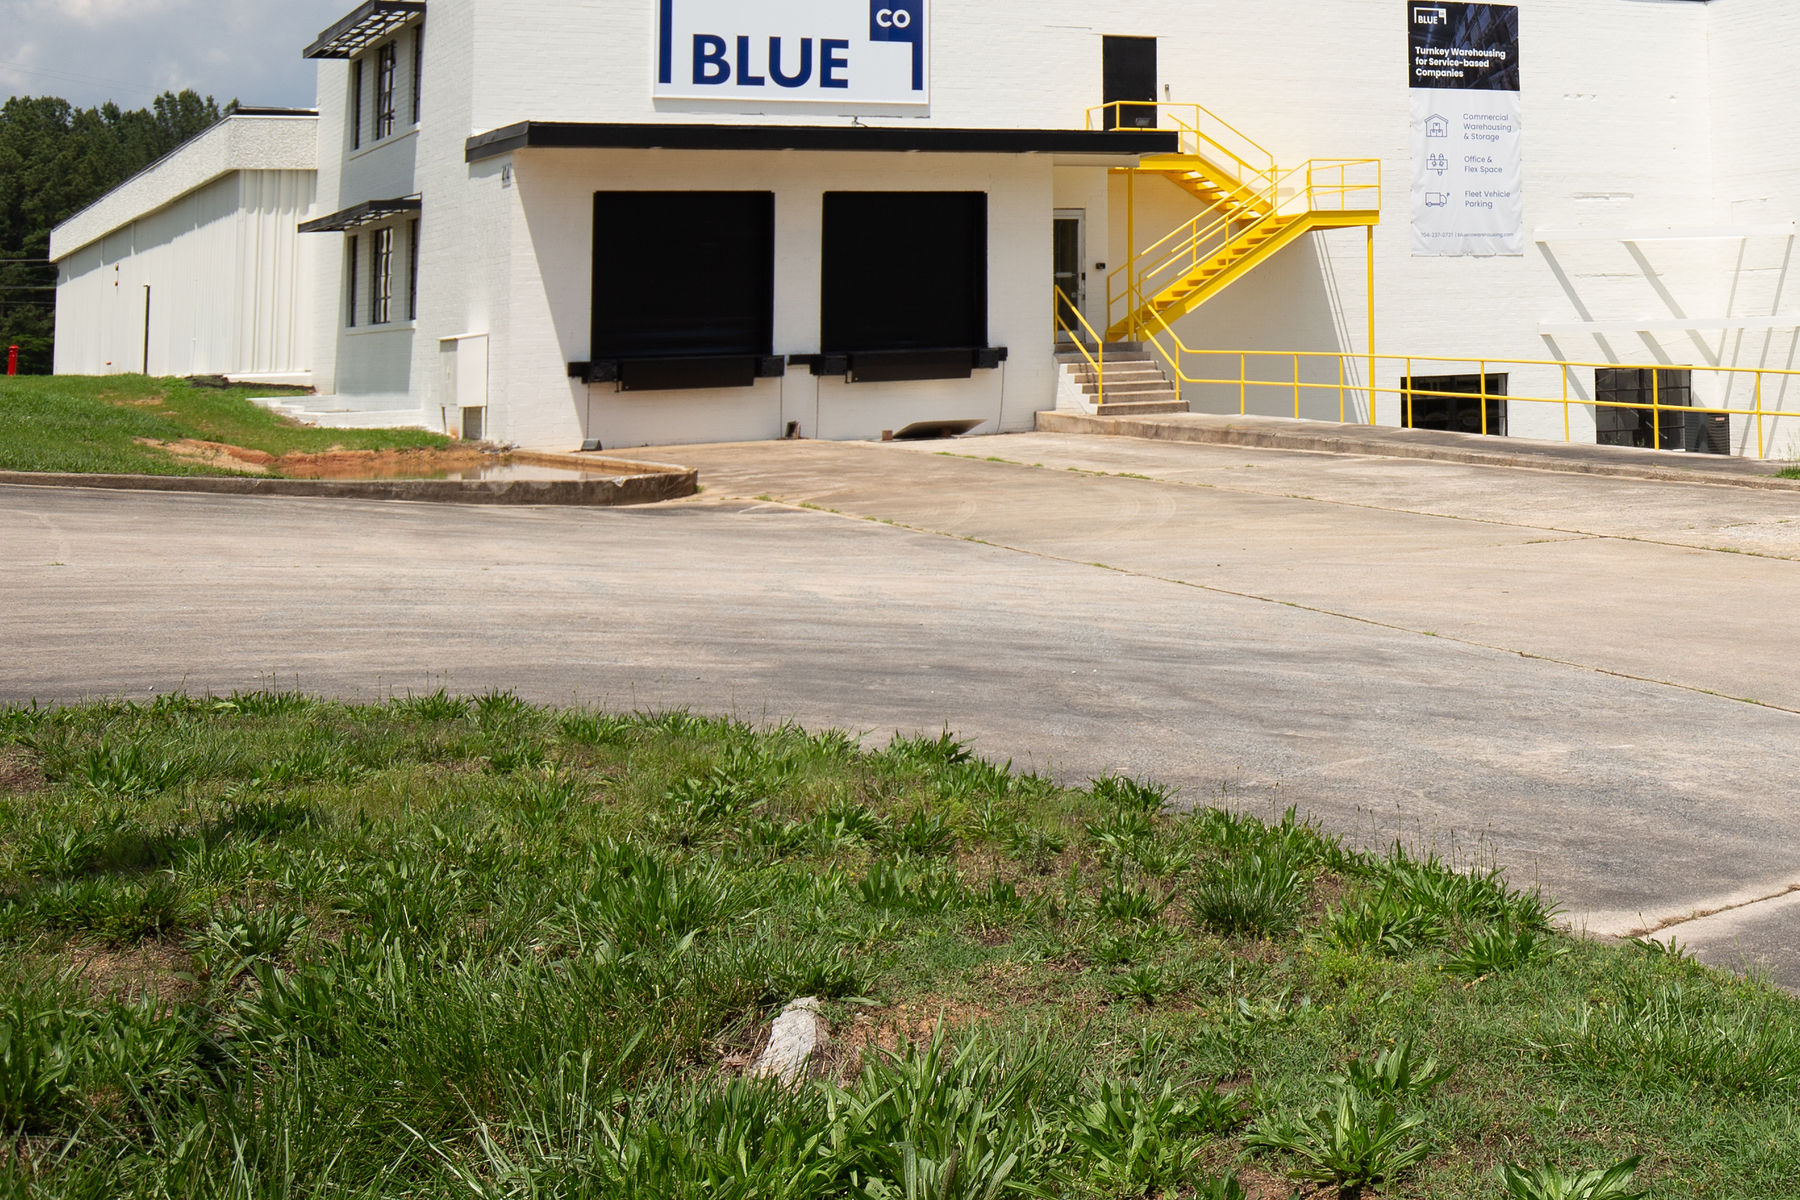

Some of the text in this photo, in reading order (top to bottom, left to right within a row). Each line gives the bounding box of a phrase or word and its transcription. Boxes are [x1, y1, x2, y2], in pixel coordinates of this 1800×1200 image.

[876, 8, 911, 29] CO
[1418, 15, 1438, 25] BLUE
[1415, 46, 1506, 60] Turnkey Warehousing
[692, 33, 850, 89] BLUE
[1415, 57, 1490, 68] for Service-based
[1415, 68, 1464, 79] Companies
[1463, 113, 1509, 121] Commercial
[1463, 123, 1512, 133] Warehousing
[1471, 133, 1500, 142] Storage
[1464, 155, 1486, 163] Office
[1480, 166, 1503, 174] Space
[1464, 190, 1511, 198] Fleet Vehicle
[1465, 200, 1493, 209] Parking
